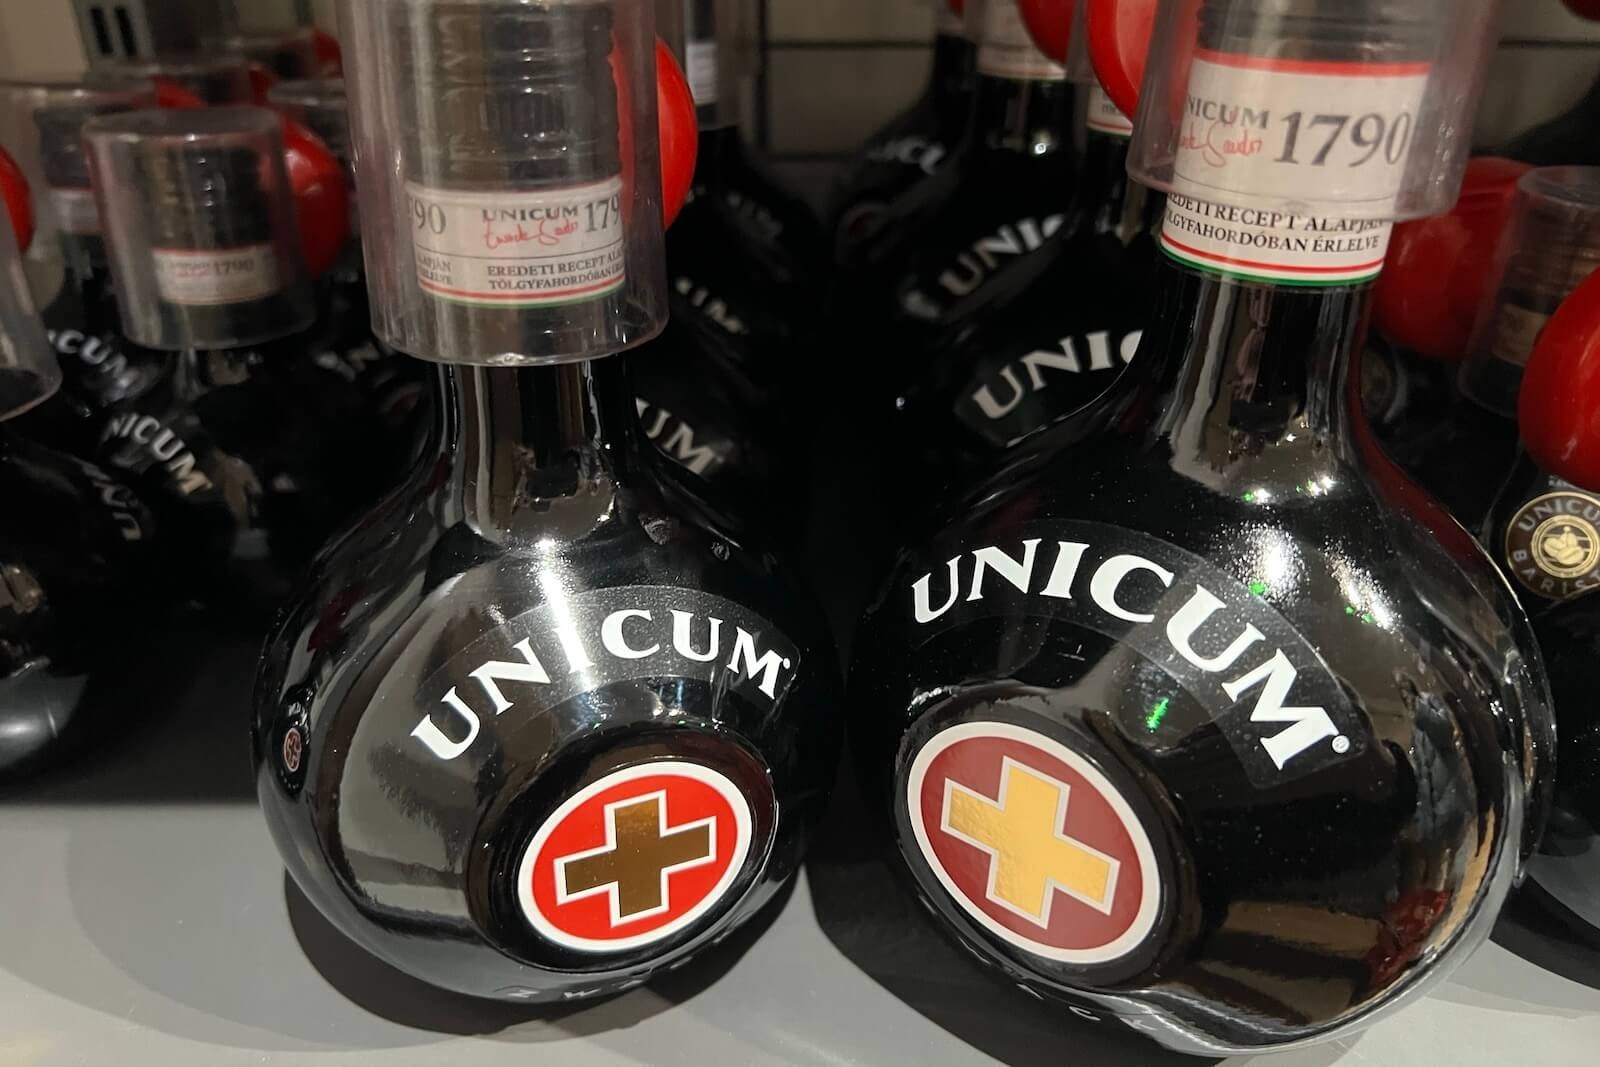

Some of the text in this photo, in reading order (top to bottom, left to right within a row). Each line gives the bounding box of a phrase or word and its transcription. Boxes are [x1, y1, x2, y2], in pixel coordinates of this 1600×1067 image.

[1184, 96, 1412, 168] NICUM 1790
[411, 195, 621, 235] 90 UNICUM 179
[1166, 206, 1307, 254] LGYFAHORDÓBAN
[1214, 205, 1298, 231] RECEPT
[487, 264, 554, 277] EREDETI
[558, 255, 604, 274] RECEPT
[101, 412, 210, 496] NICUM
[1518, 499, 1600, 533] UNICU
[910, 538, 1340, 771] UNICUM
[410, 608, 788, 760] UNICUM
